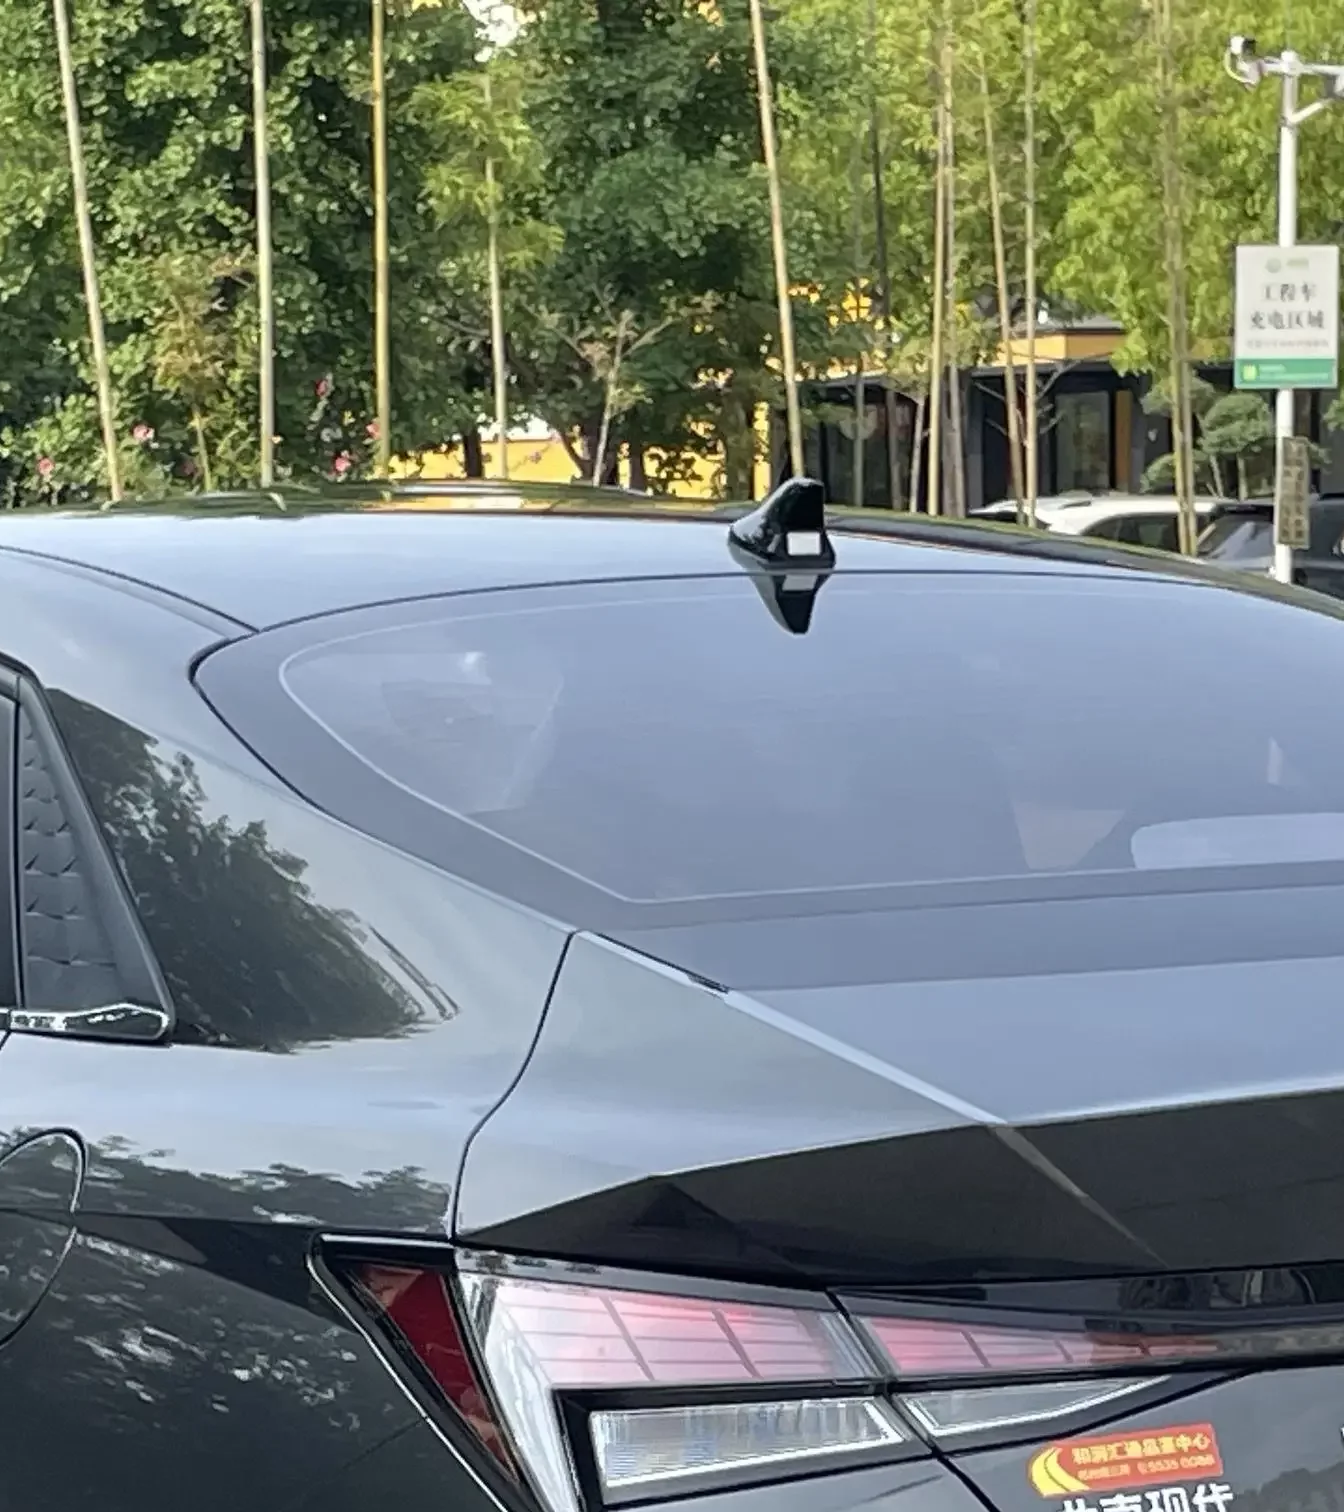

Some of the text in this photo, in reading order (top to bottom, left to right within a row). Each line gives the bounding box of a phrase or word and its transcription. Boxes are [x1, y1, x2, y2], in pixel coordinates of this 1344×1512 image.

[1260, 281, 1318, 302] 工程车
[1249, 308, 1326, 331] 充电区域
